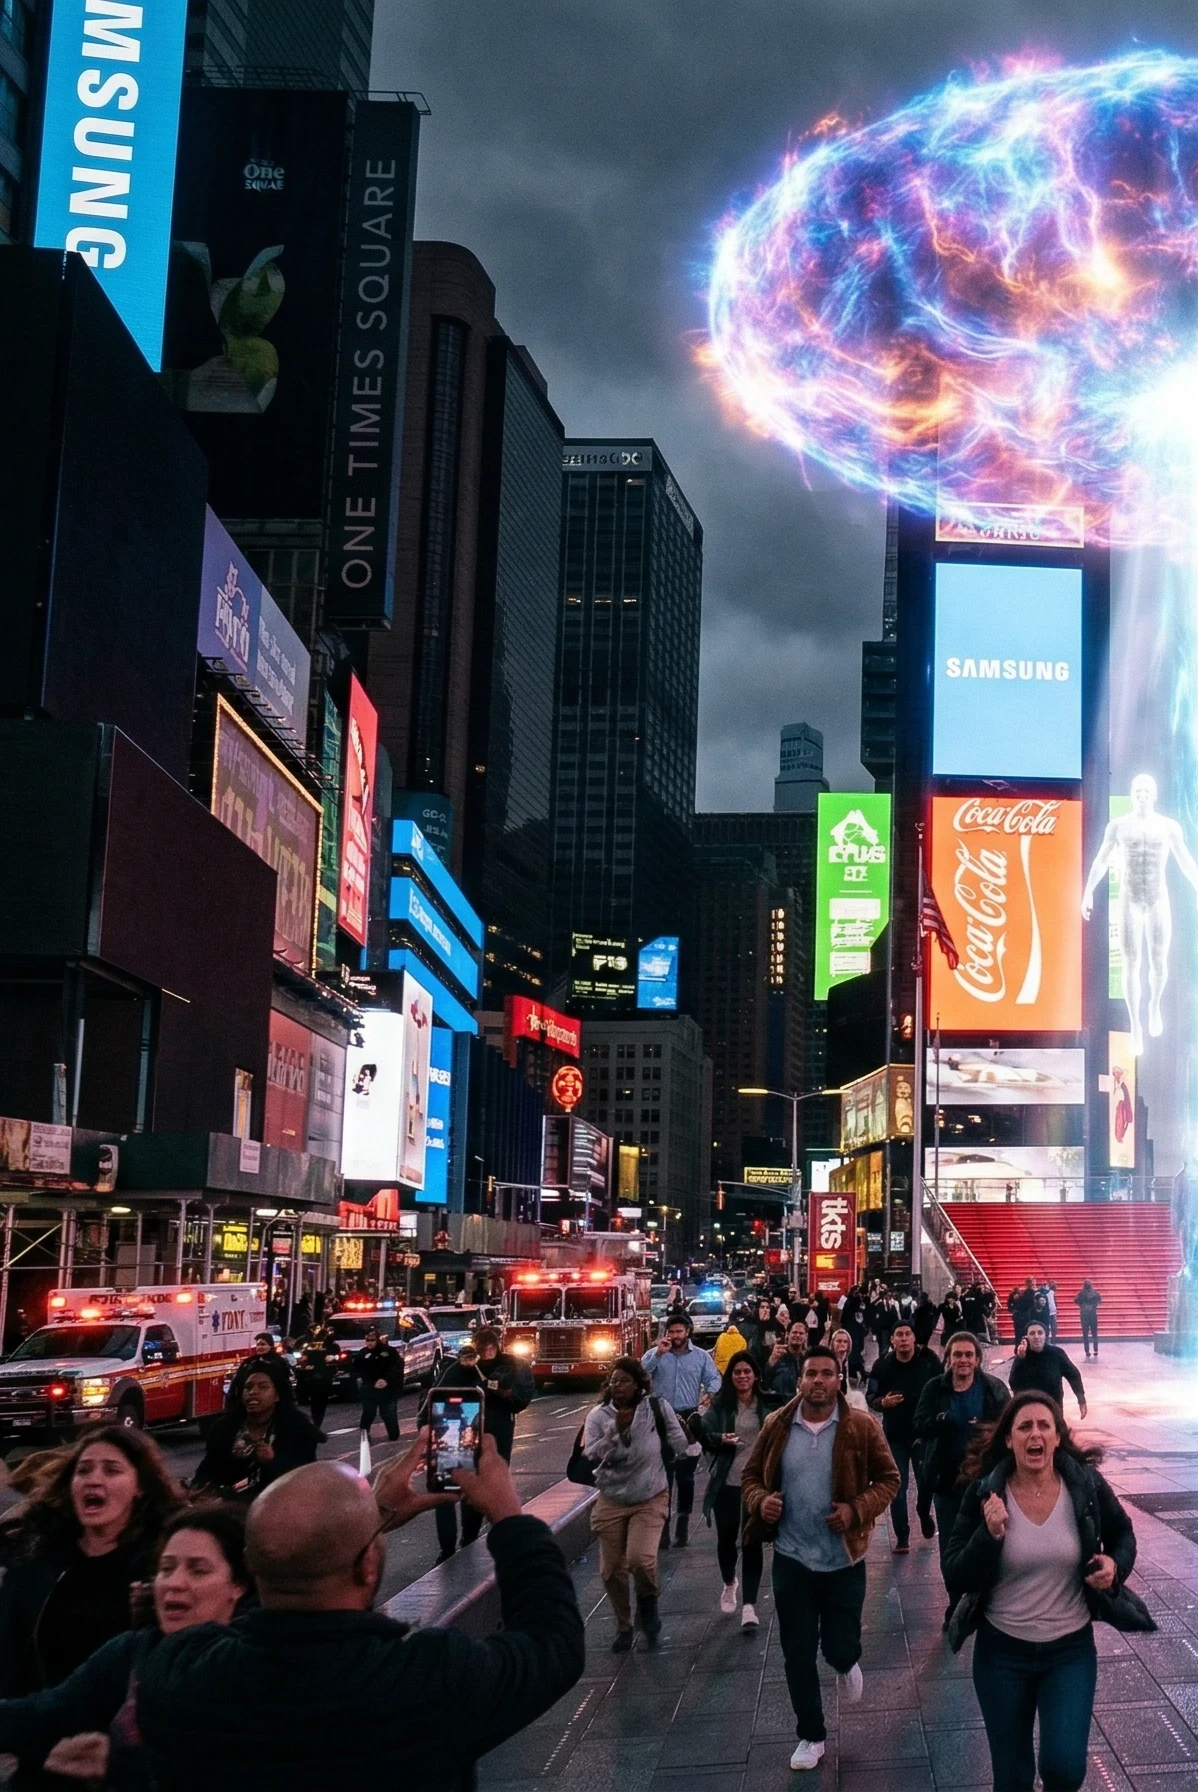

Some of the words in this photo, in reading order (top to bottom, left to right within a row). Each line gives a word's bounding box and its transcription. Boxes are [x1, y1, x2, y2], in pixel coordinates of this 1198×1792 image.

[243, 163, 285, 179] One
[356, 158, 396, 331] SQUARE
[348, 350, 384, 475] TIMES
[341, 497, 376, 588] ONE
[946, 657, 1070, 682] SAMSUNG
[820, 1197, 849, 1250] tkts
